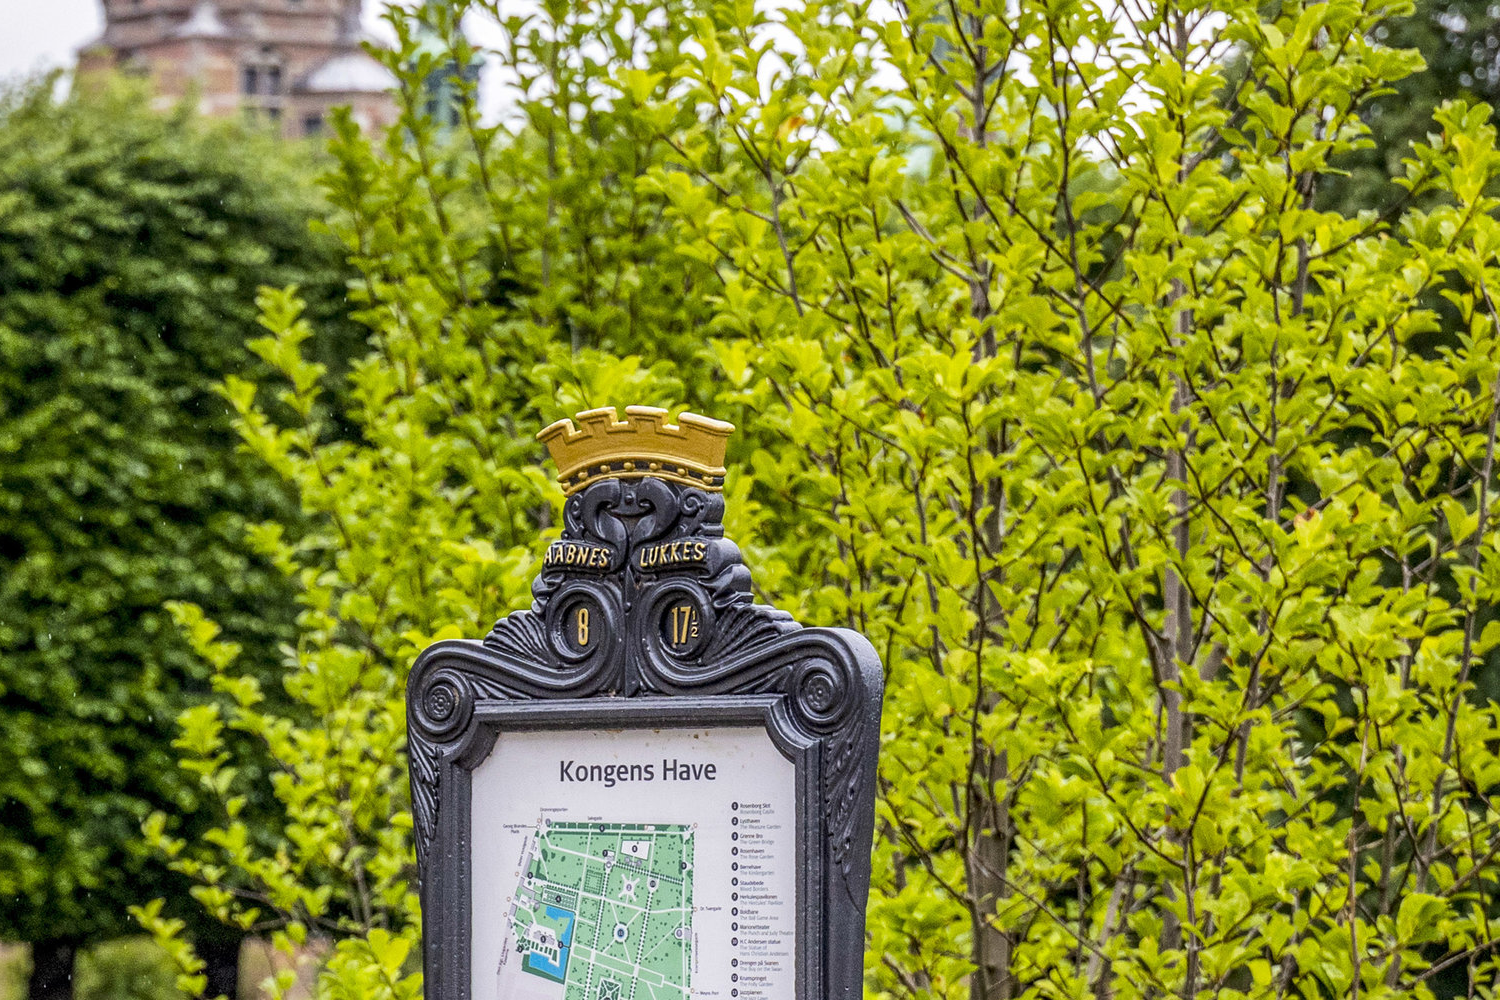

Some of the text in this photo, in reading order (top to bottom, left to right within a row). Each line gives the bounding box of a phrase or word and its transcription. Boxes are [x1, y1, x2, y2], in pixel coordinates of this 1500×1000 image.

[640, 541, 706, 568] LUKKES
[577, 608, 589, 646] 8
[560, 759, 717, 788] Kongens Have
